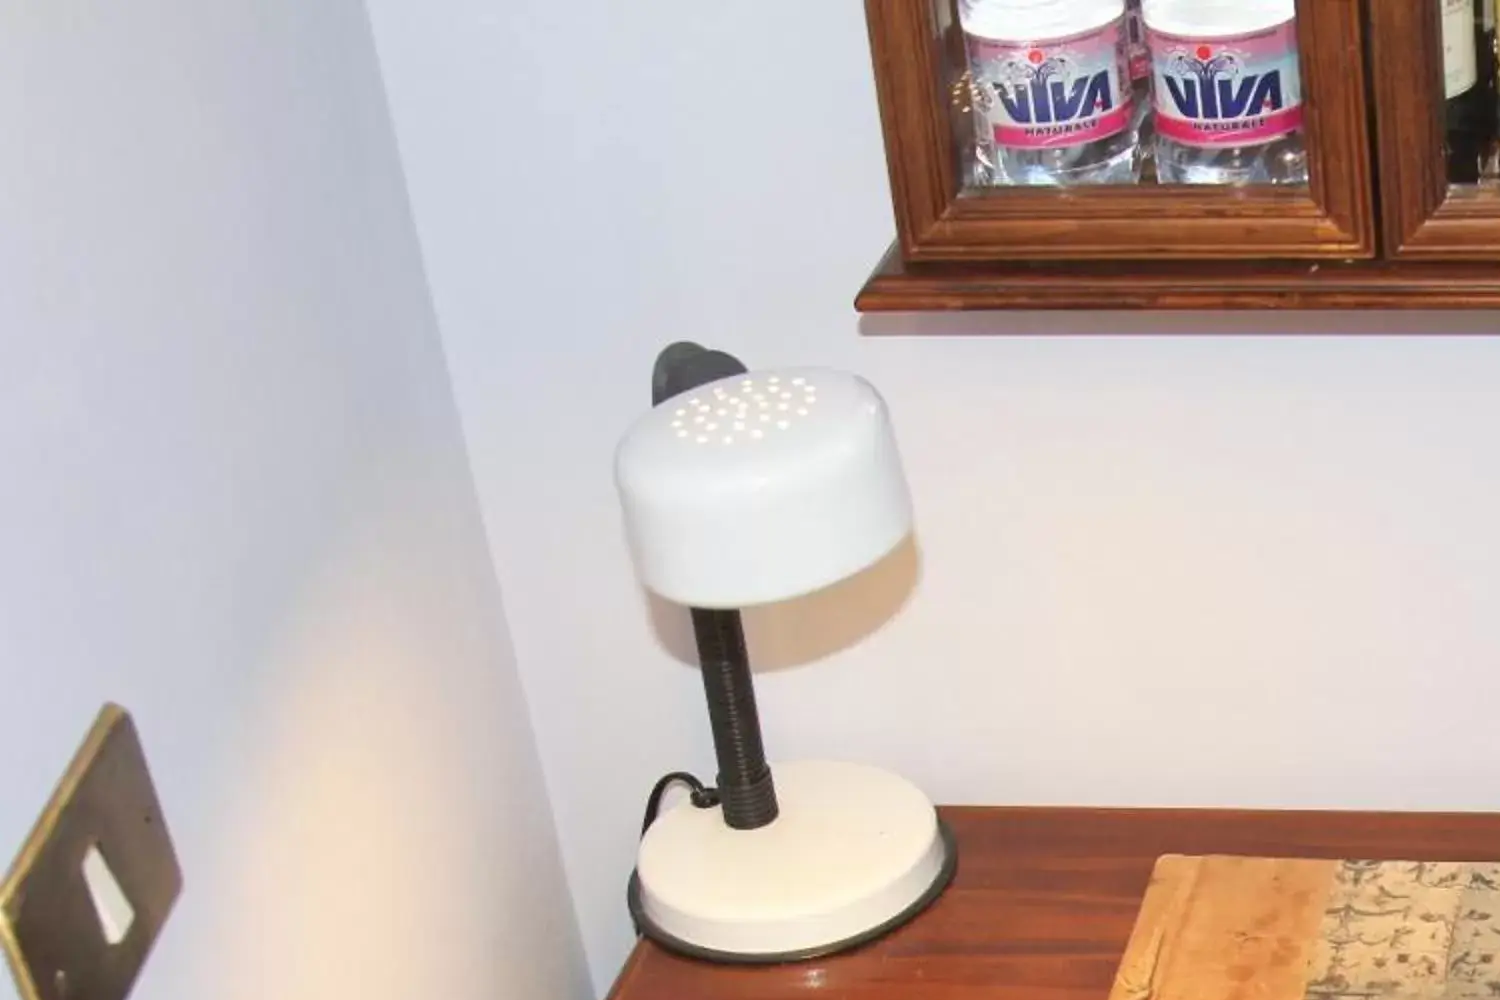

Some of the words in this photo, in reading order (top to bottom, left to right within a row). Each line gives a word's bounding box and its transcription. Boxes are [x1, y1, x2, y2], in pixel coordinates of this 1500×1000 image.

[992, 69, 1113, 123] VIVA
[1163, 69, 1282, 119] VIVA
[1025, 119, 1097, 137] NATURALE
